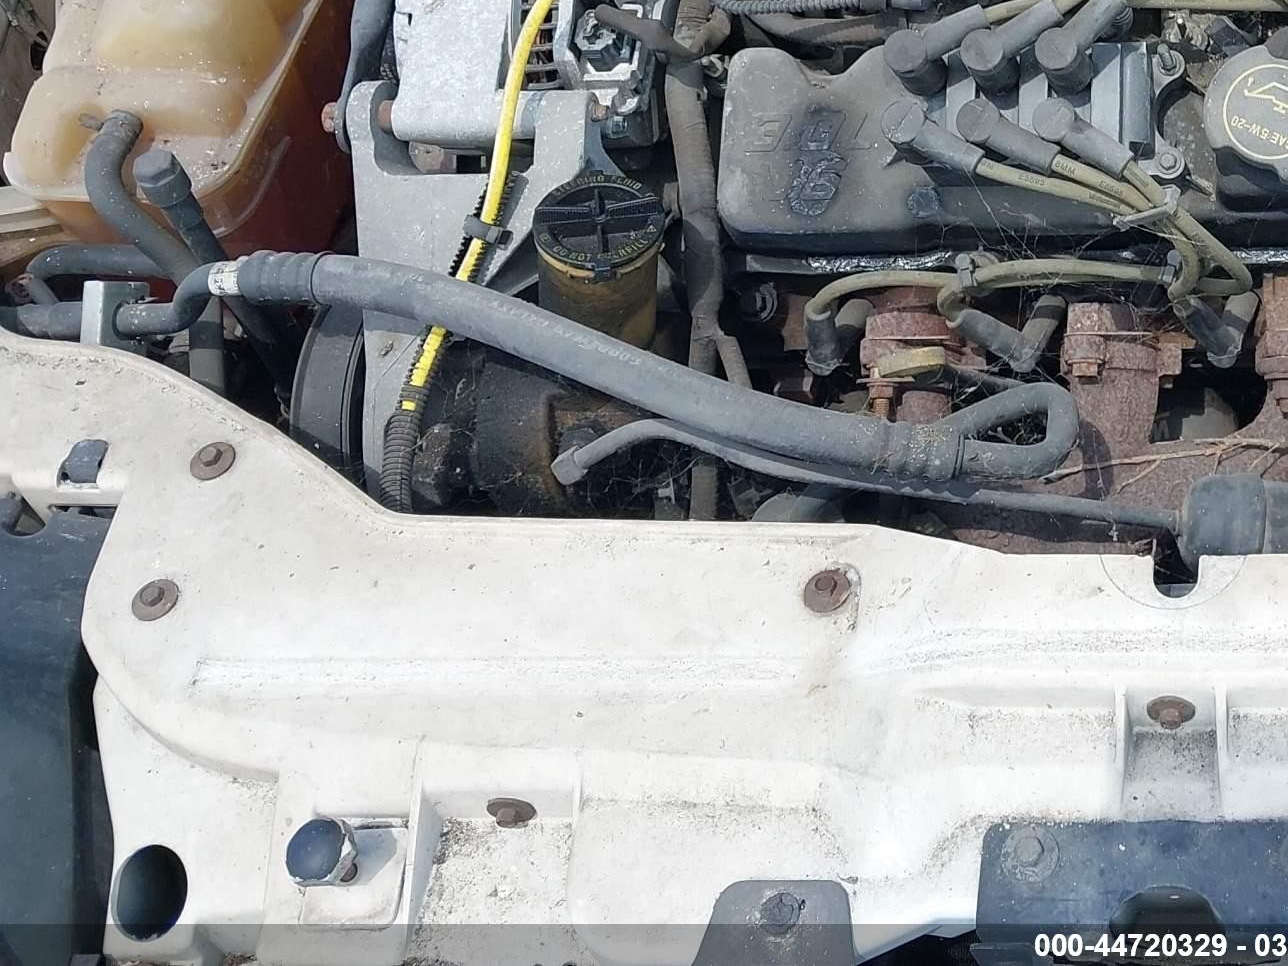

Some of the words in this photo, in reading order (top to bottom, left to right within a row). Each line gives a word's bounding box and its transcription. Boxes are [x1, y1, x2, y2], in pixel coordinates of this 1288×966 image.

[1230, 114, 1270, 139] 5W-20
[552, 174, 606, 196] STEERING
[611, 175, 643, 189] FLUID
